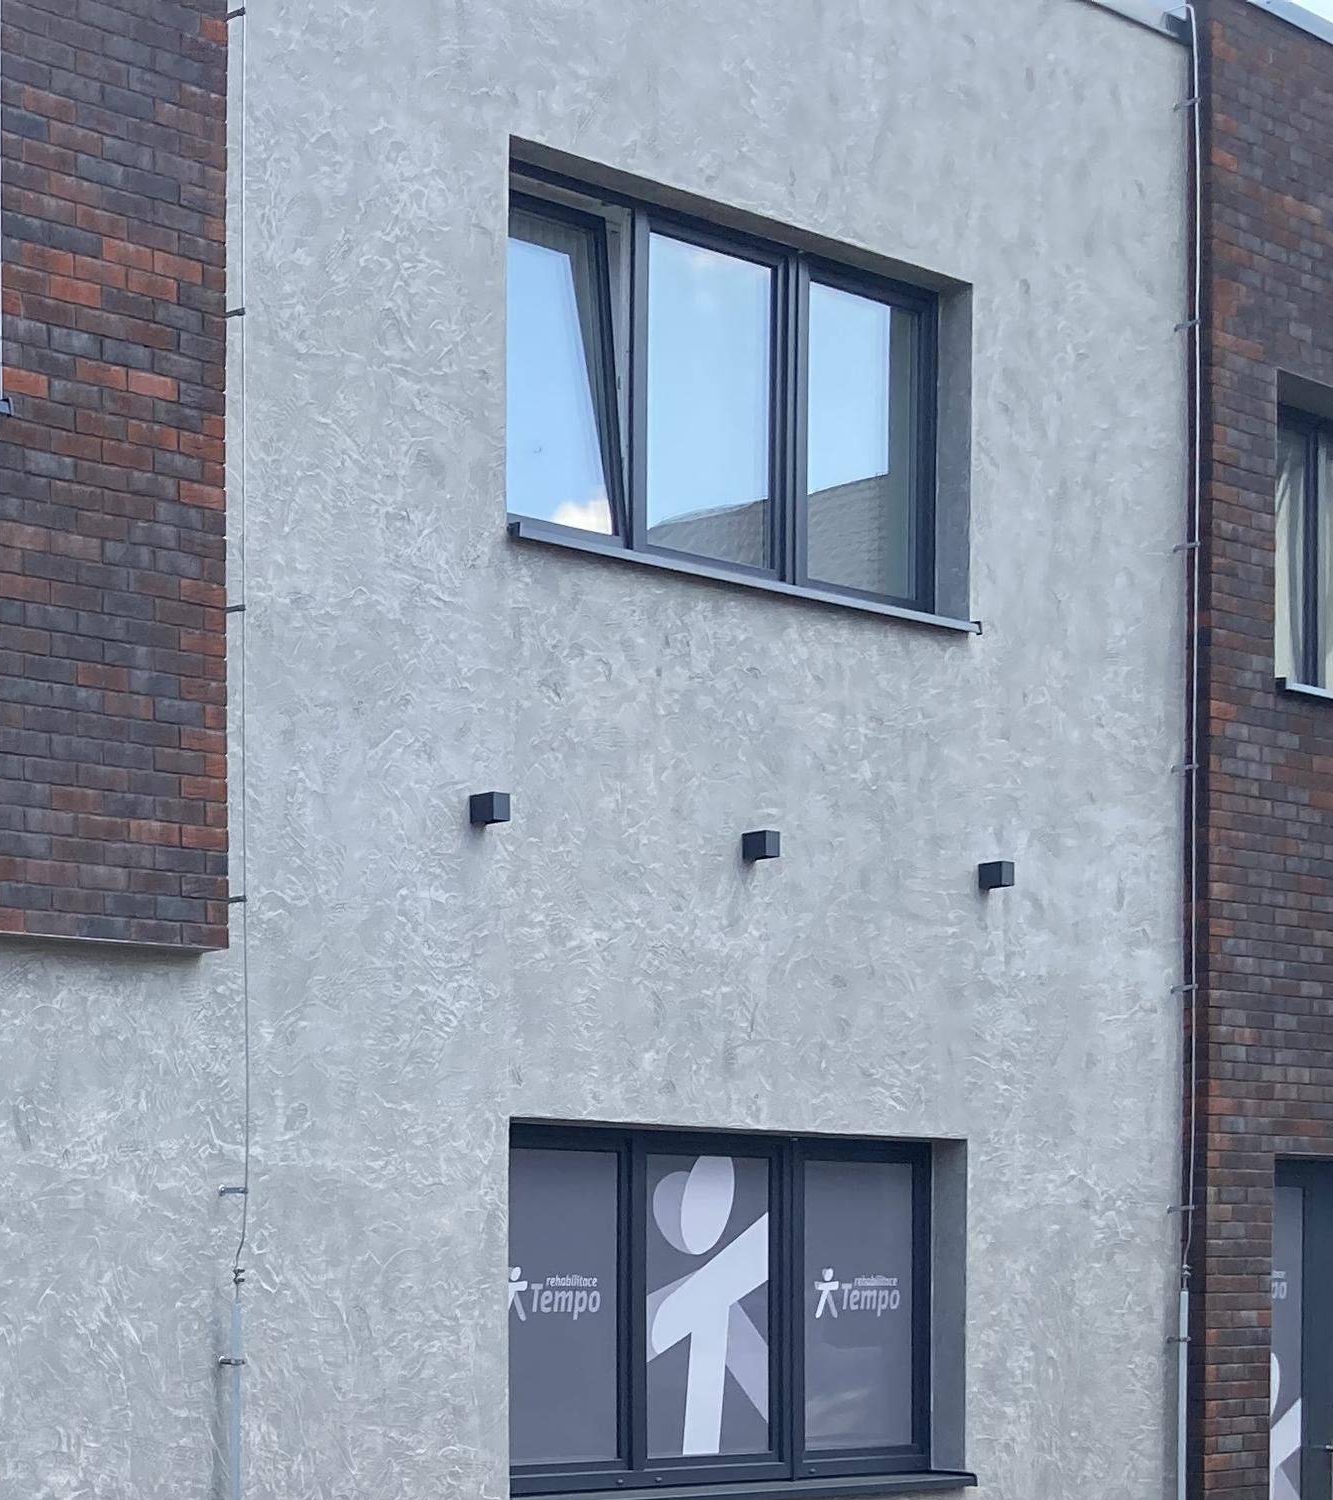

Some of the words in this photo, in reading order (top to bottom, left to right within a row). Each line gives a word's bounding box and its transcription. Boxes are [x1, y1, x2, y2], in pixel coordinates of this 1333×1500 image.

[546, 1274, 598, 1287] rehabilitace
[531, 1283, 601, 1320] Tempo
[841, 1283, 900, 1317] Tempo
